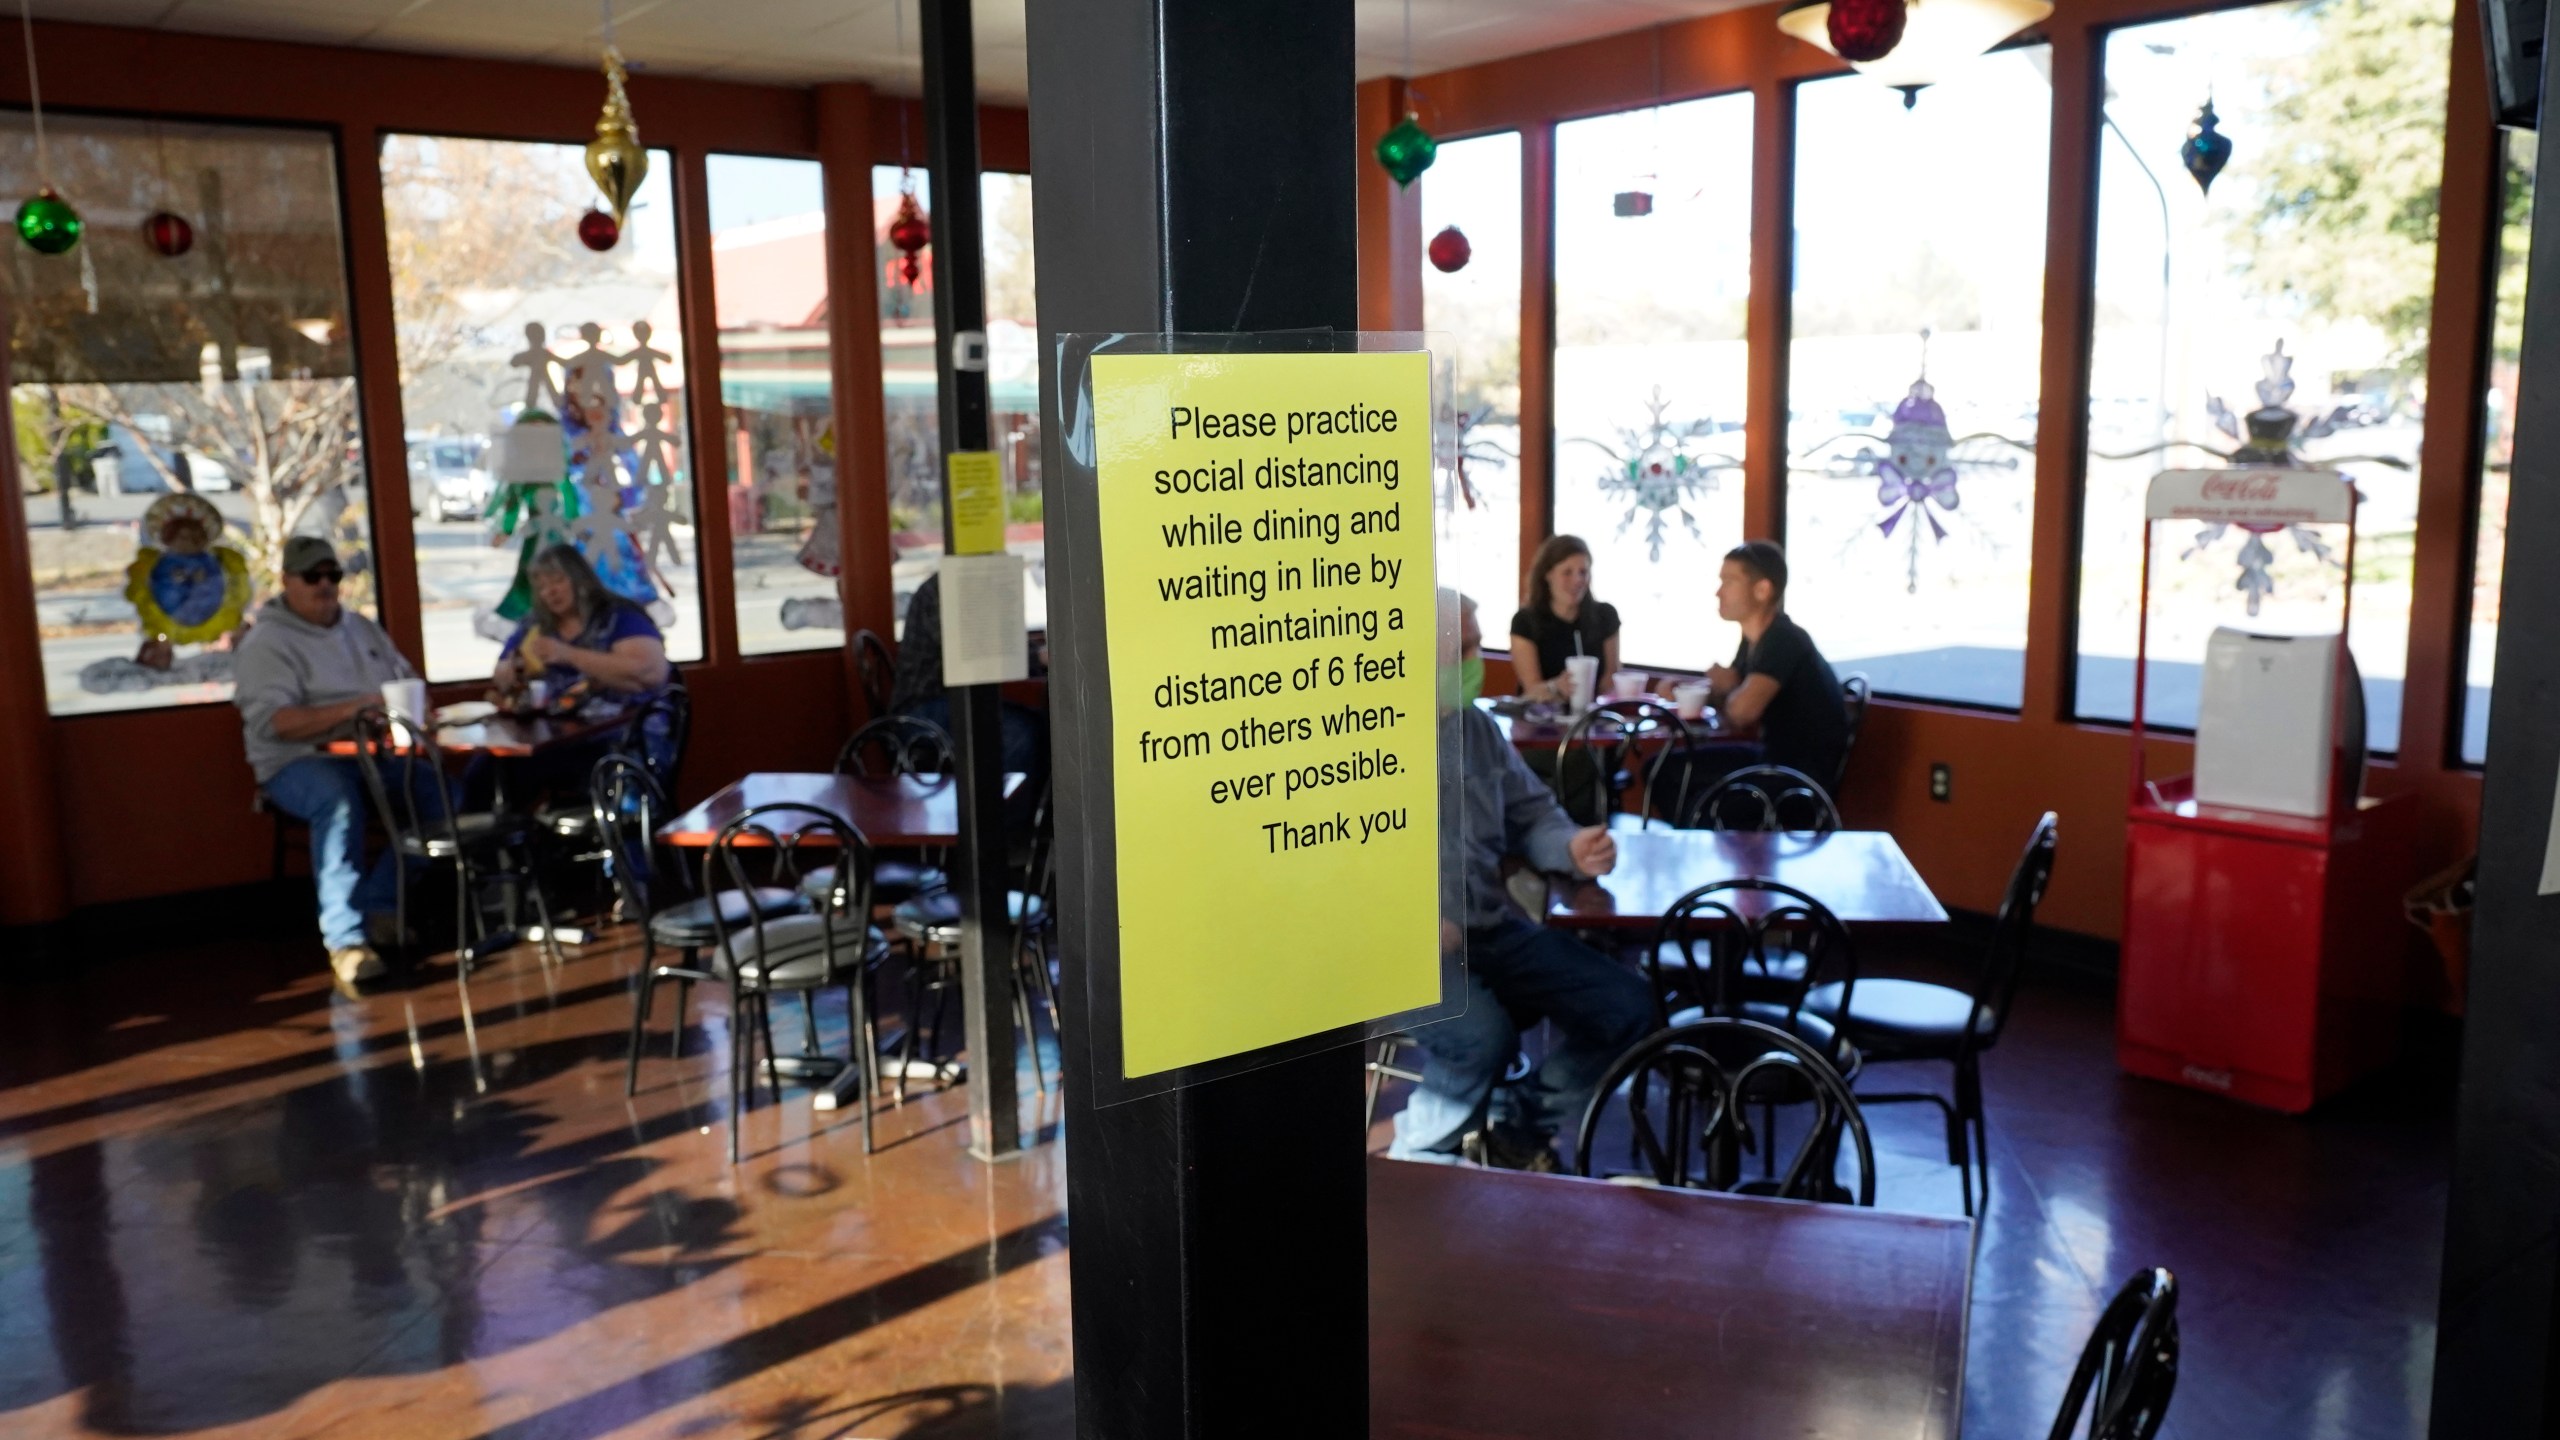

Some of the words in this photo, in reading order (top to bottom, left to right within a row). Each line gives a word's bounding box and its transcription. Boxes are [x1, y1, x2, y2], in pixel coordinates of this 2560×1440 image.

[1170, 406, 1277, 440] Please
[1287, 402, 1398, 444] practice
[1154, 458, 1244, 495] social
[1255, 453, 1399, 491] distancing
[1161, 512, 1243, 548] while
[1253, 507, 1340, 545] dining
[1350, 501, 1400, 535] and
[1157, 564, 1267, 603] waiting
[1277, 560, 1302, 592] in
[1312, 557, 1361, 589] line
[1371, 552, 1403, 590] by
[1211, 605, 1378, 650] maintaining
[1388, 607, 1404, 631] a
[1154, 671, 1282, 709] distance
[1292, 657, 1321, 692] of
[1328, 656, 1345, 687] 6
[1353, 649, 1406, 684] feet
[1139, 730, 1211, 763] from
[1221, 717, 1312, 752] others
[1321, 703, 1406, 737] when-
[1210, 772, 1276, 804] ever
[1285, 748, 1405, 801] possible.
[1261, 811, 1351, 854] Thank
[1359, 807, 1407, 845] you
